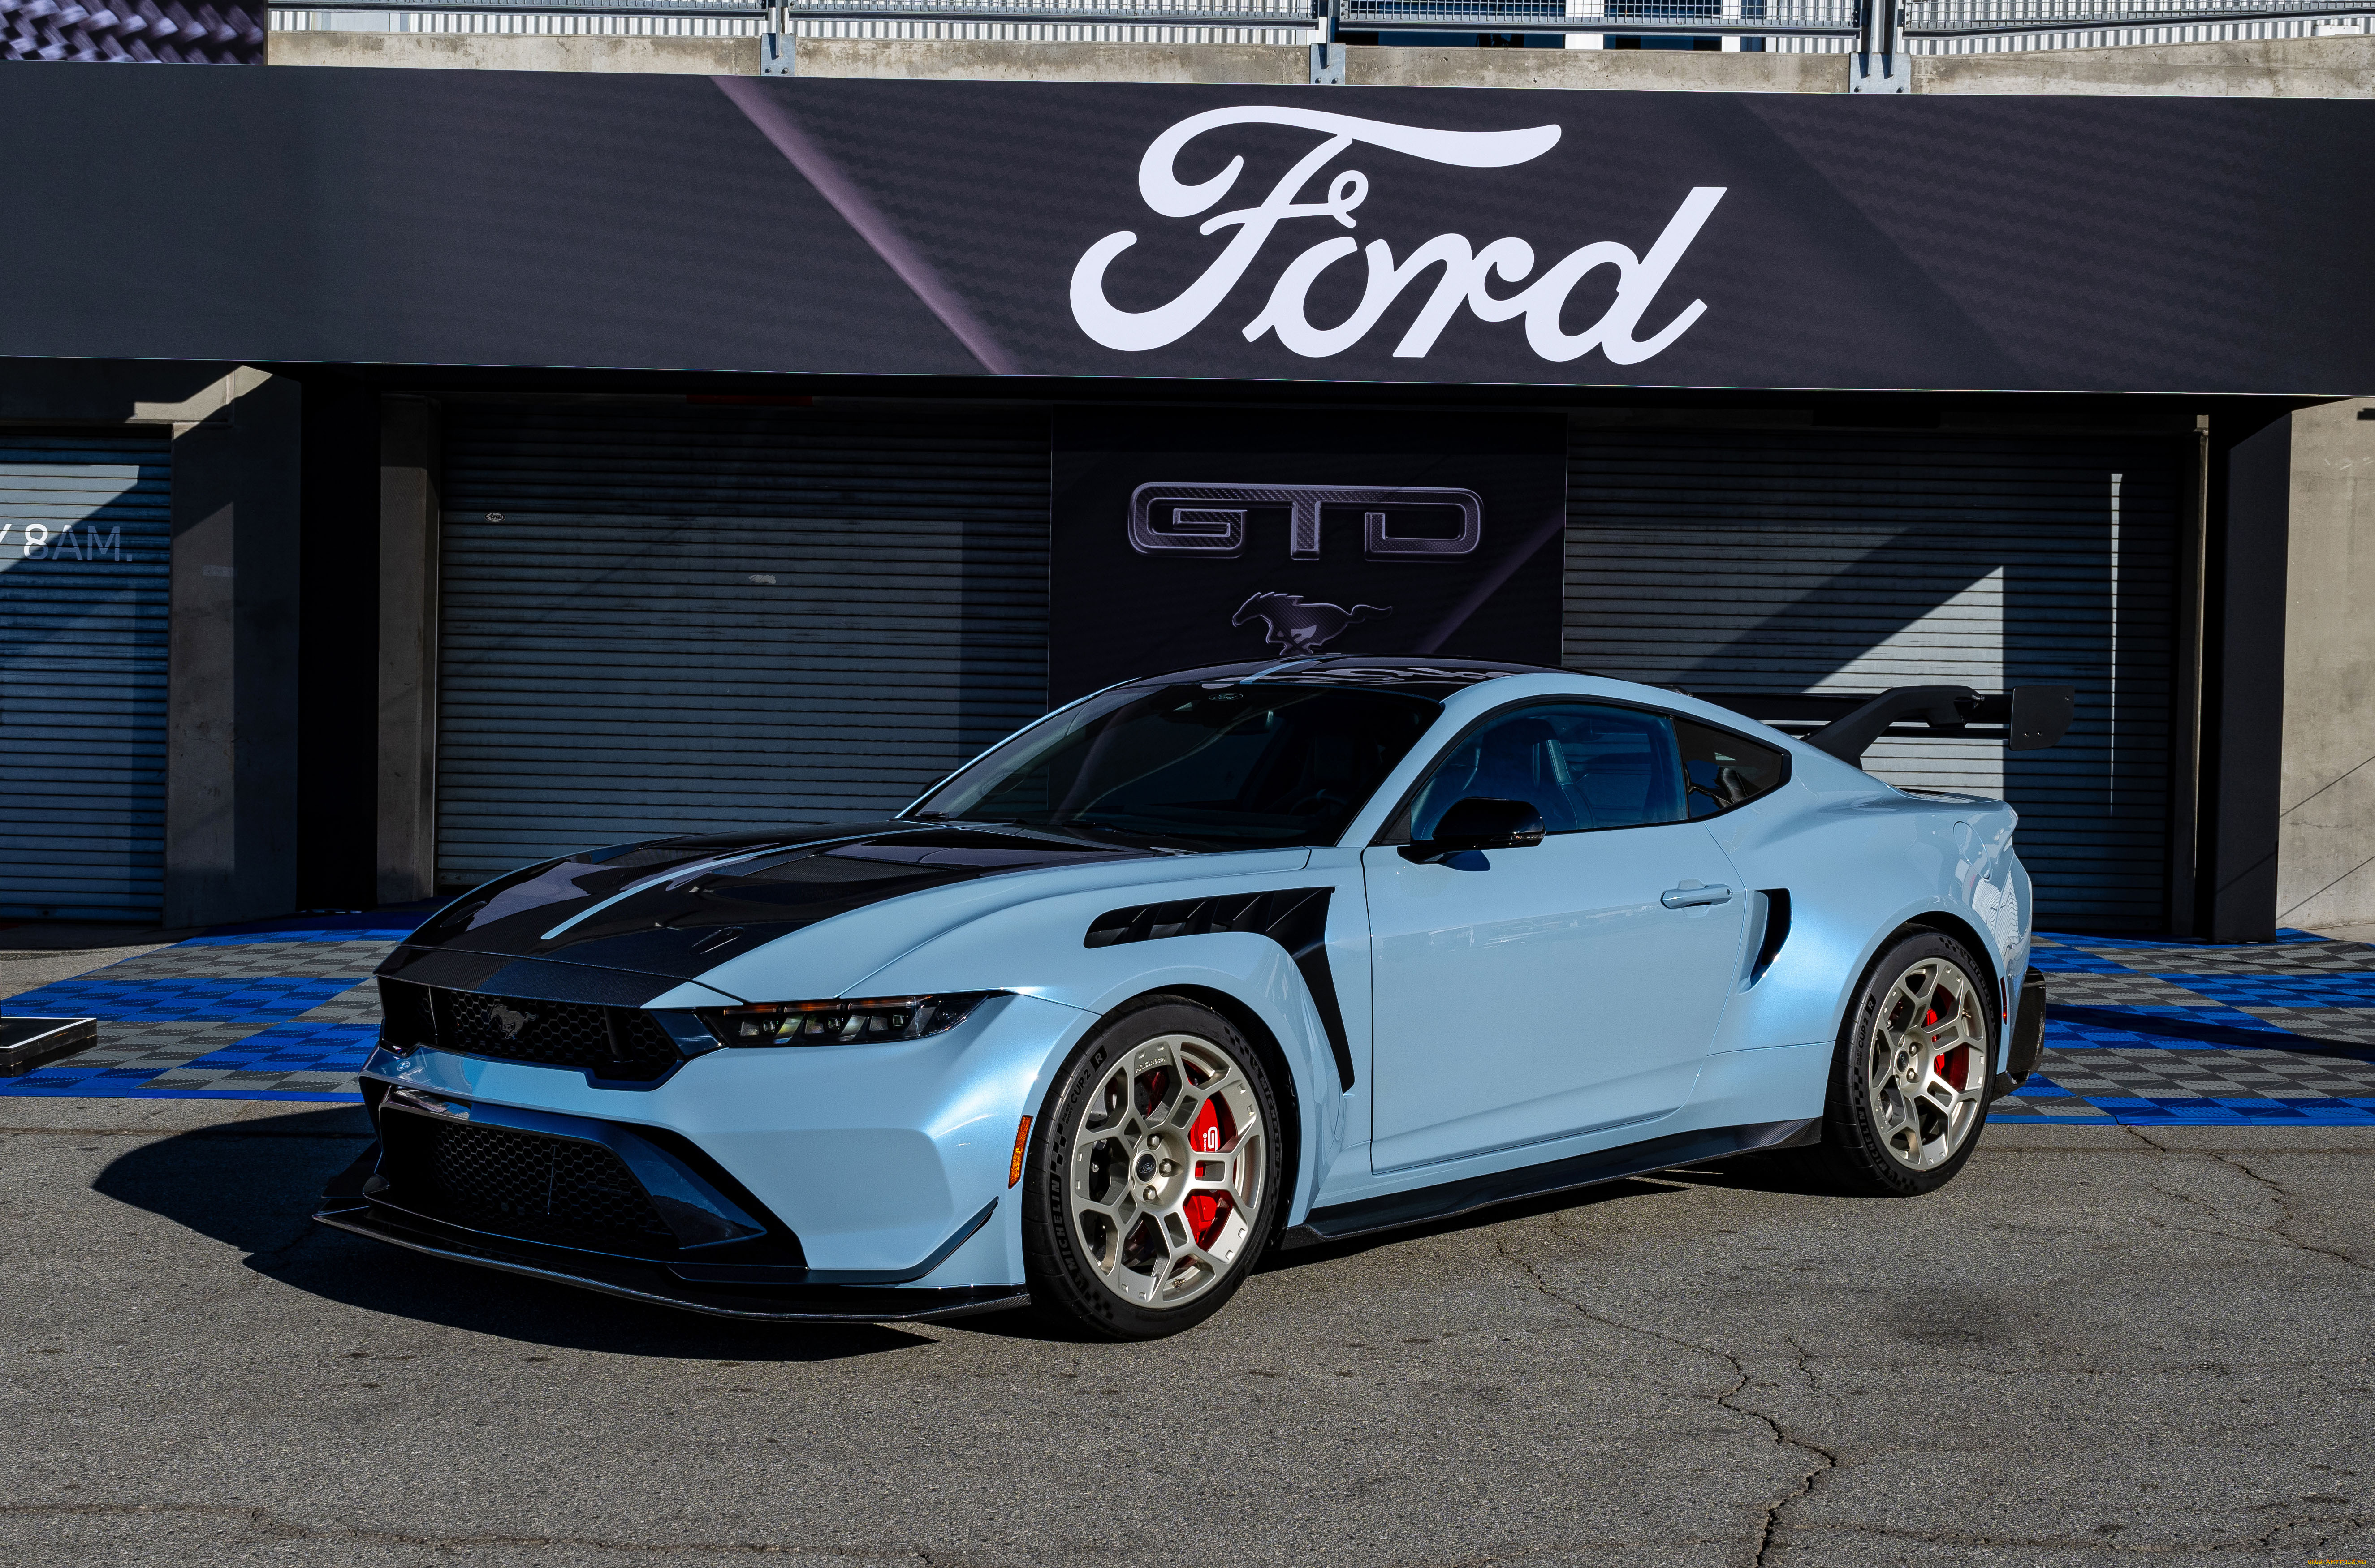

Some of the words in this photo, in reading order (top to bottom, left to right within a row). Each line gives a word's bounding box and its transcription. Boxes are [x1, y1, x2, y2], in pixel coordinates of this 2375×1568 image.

[1070, 105, 1727, 365] Ford
[24, 523, 133, 562] 8AM.
[1128, 482, 1484, 563] GTD
[1858, 1025, 1867, 1048] CUP
[1863, 1017, 1869, 1026] 2
[1868, 1000, 1874, 1010] R
[1070, 1077, 1085, 1104] CUP
[1084, 1069, 1091, 1080] 2
[1095, 1053, 1103, 1064] R
[1259, 1076, 1280, 1162] MICHELIN
[1858, 1111, 1888, 1171] MICHELIN
[1052, 1179, 1078, 1271] MICHELIN
